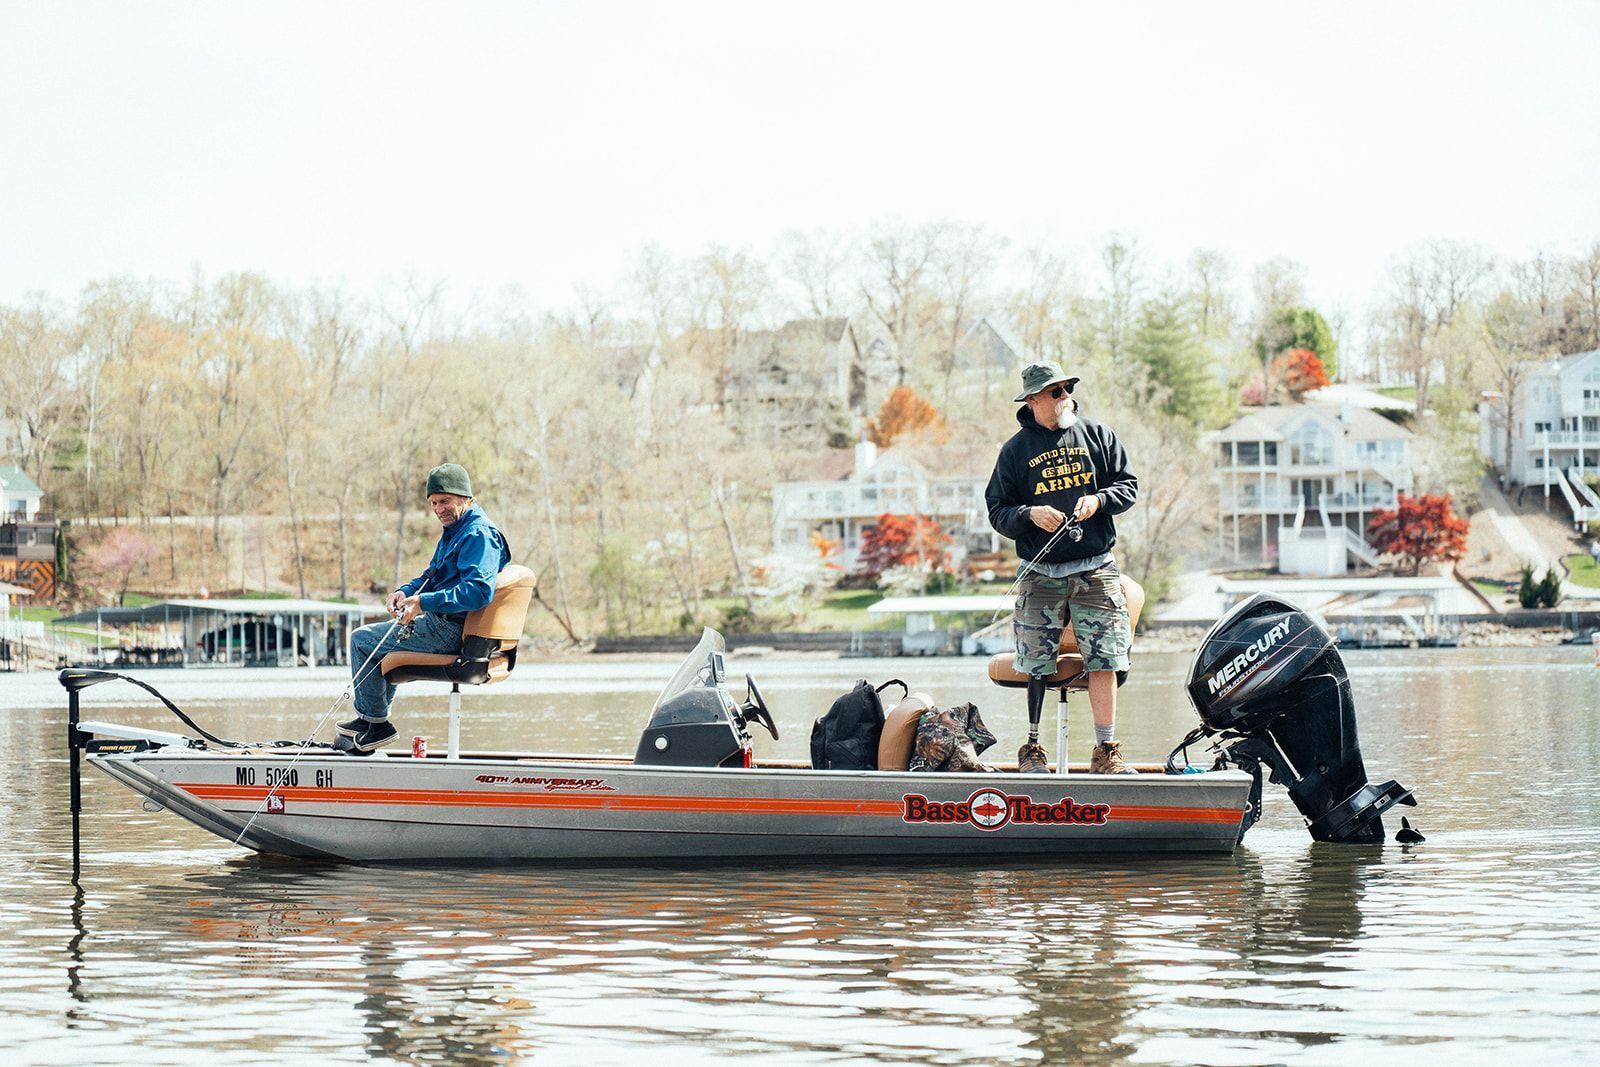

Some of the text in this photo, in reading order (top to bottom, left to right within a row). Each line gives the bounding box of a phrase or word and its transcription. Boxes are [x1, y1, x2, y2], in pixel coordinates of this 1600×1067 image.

[1034, 472, 1094, 495] ARMY
[1207, 616, 1291, 695] MERCURY
[236, 767, 255, 786] MO
[316, 769, 333, 788] GH
[475, 775, 604, 786] 40TH ANNIVERSARY
[904, 796, 1108, 823] Bass Tracker
